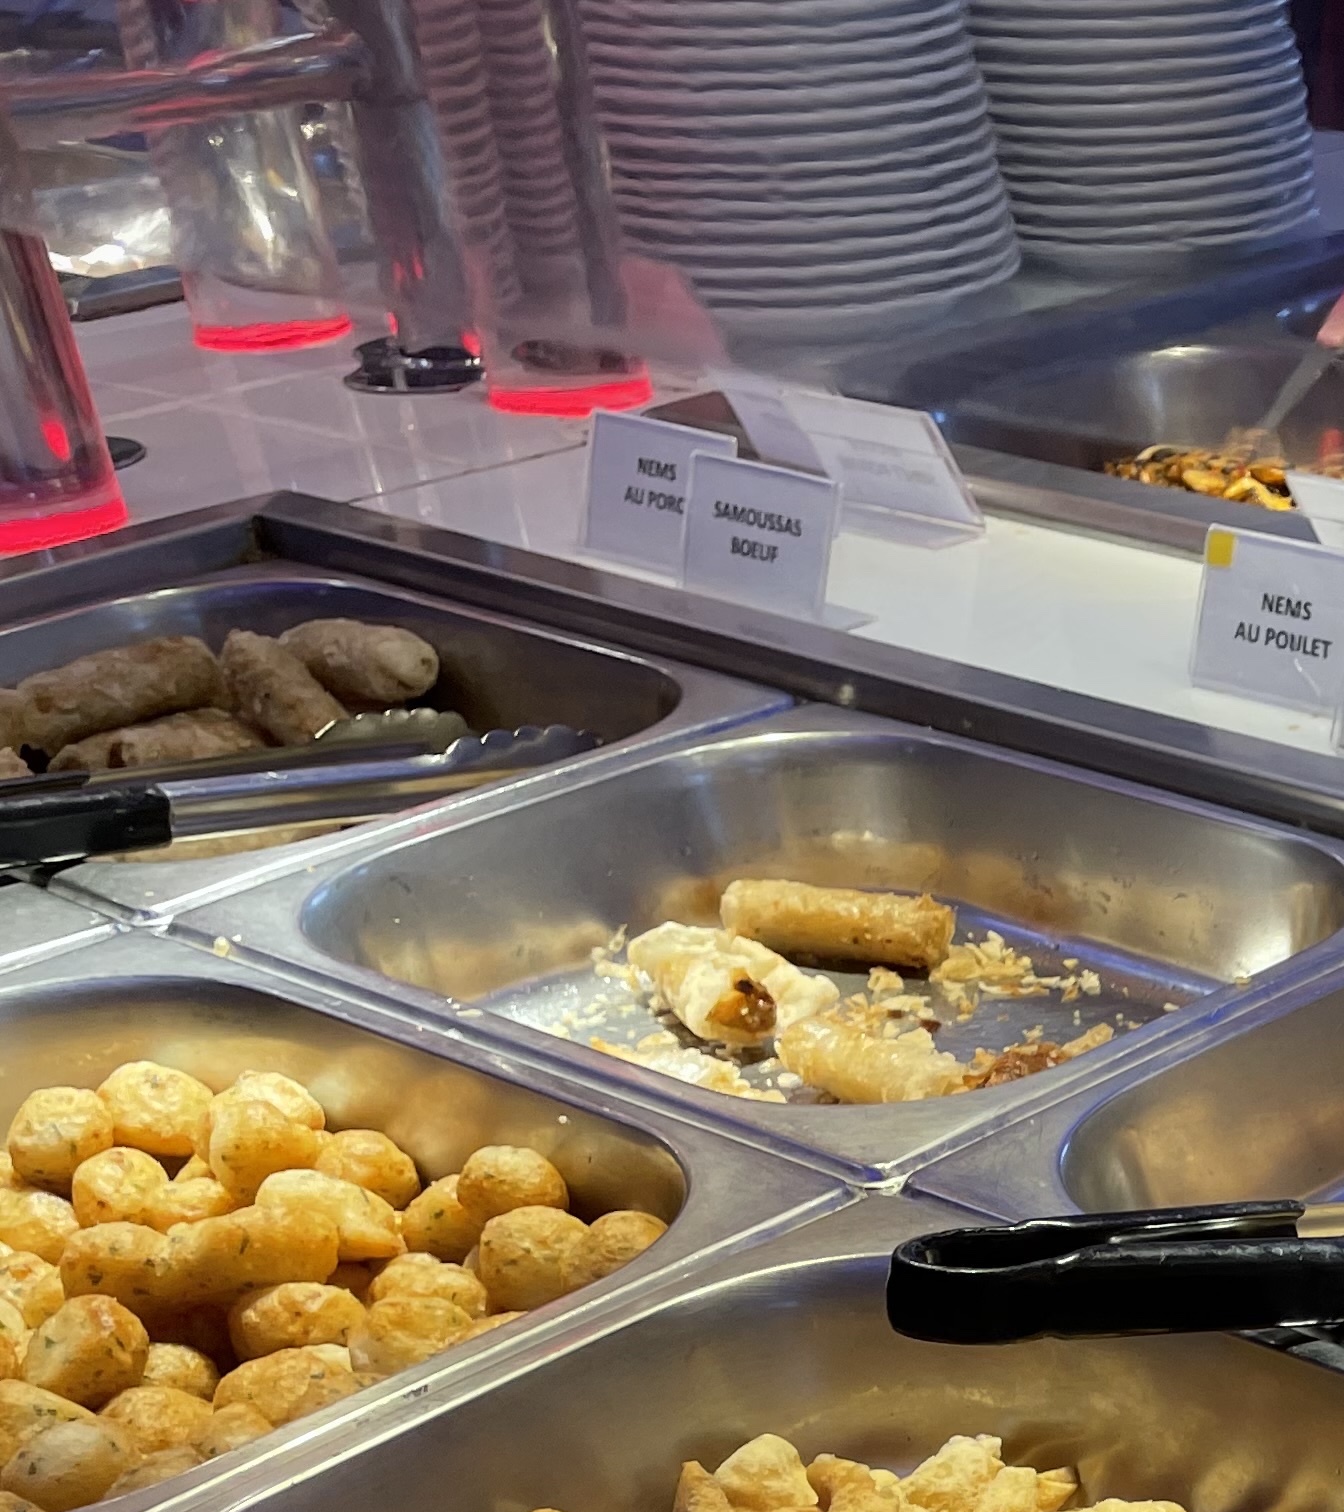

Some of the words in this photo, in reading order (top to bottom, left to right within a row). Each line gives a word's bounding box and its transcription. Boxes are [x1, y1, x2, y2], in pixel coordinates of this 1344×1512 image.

[637, 457, 677, 482] NEMS
[624, 486, 644, 506] AU
[647, 490, 685, 515] PORC
[713, 500, 802, 537] SAMOUSSAS
[730, 536, 780, 564] BOEUF
[1260, 592, 1313, 621] NEMS
[1234, 621, 1260, 643] AU
[1264, 627, 1333, 659] POULET
